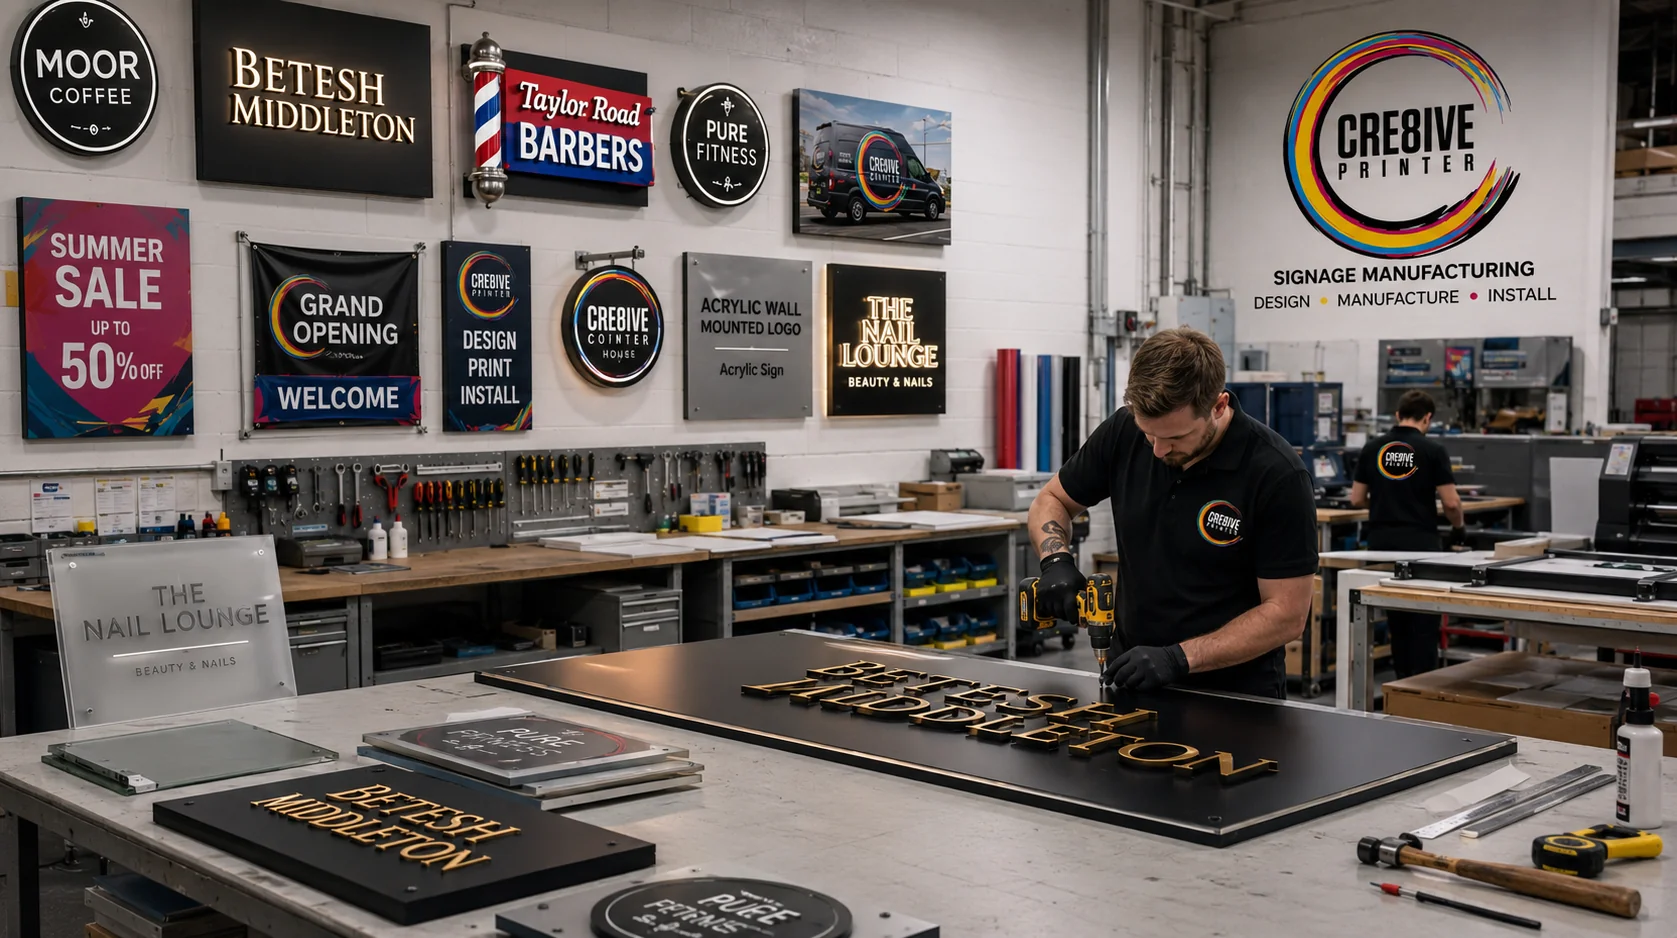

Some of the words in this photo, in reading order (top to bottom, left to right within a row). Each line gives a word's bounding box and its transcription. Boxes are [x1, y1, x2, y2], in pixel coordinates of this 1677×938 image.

[36, 49, 140, 79] MOOR
[231, 47, 384, 106] BETESH
[50, 87, 132, 105] COFFEE
[232, 94, 416, 144] MIDDLETON
[592, 95, 641, 126] Road
[706, 119, 748, 143] PURE
[1337, 103, 1475, 159] CRE8IVE
[520, 121, 643, 172] BARBERS
[697, 142, 757, 166] FITNESS
[1338, 153, 1475, 180] PRINTER
[50, 232, 163, 263] SUMMER
[471, 273, 510, 290] CRE8IVE
[1273, 267, 1356, 285] SIGNAGE
[1362, 260, 1535, 282] MANUFACTURING
[55, 265, 162, 310] SALE
[1254, 295, 1310, 309] DESIGN
[1337, 290, 1459, 307] MANUFACTURE
[1488, 287, 1556, 302] INSTALL
[300, 293, 383, 318] GRAND
[700, 297, 761, 315] ACRYLIC
[766, 300, 801, 317] WALL
[866, 296, 914, 321] THE
[91, 320, 109, 335] UP
[113, 321, 130, 335] TO
[587, 305, 649, 332] CRE8IVE
[700, 319, 763, 336] MOUNTED
[768, 322, 801, 336] LOGO
[293, 321, 398, 345] OPENING
[463, 330, 517, 350] DESIGN
[861, 319, 921, 344] NAIL
[61, 342, 138, 389] 50%
[141, 363, 163, 380] OFF
[468, 358, 512, 378] PRINT
[841, 343, 939, 368] LOUNGE
[719, 362, 757, 379] Acrylic
[760, 364, 784, 379] Sign
[848, 376, 889, 387] BEAUTY
[893, 376, 900, 387] &
[904, 376, 933, 387] NAILS
[277, 386, 399, 410] WELCOME
[461, 385, 520, 405] INSTALL
[152, 583, 205, 606] THE
[83, 615, 150, 641] NAIL
[161, 604, 269, 634] LOUNGE
[135, 663, 183, 677] BEAUTY
[189, 661, 196, 670] &
[202, 657, 236, 669] NAILS
[807, 660, 1158, 731] BETESH
[497, 727, 585, 748] PURE
[741, 677, 1280, 780] MIDDLETON
[326, 783, 521, 844] BETESH
[250, 792, 491, 871] MIDDLETON
